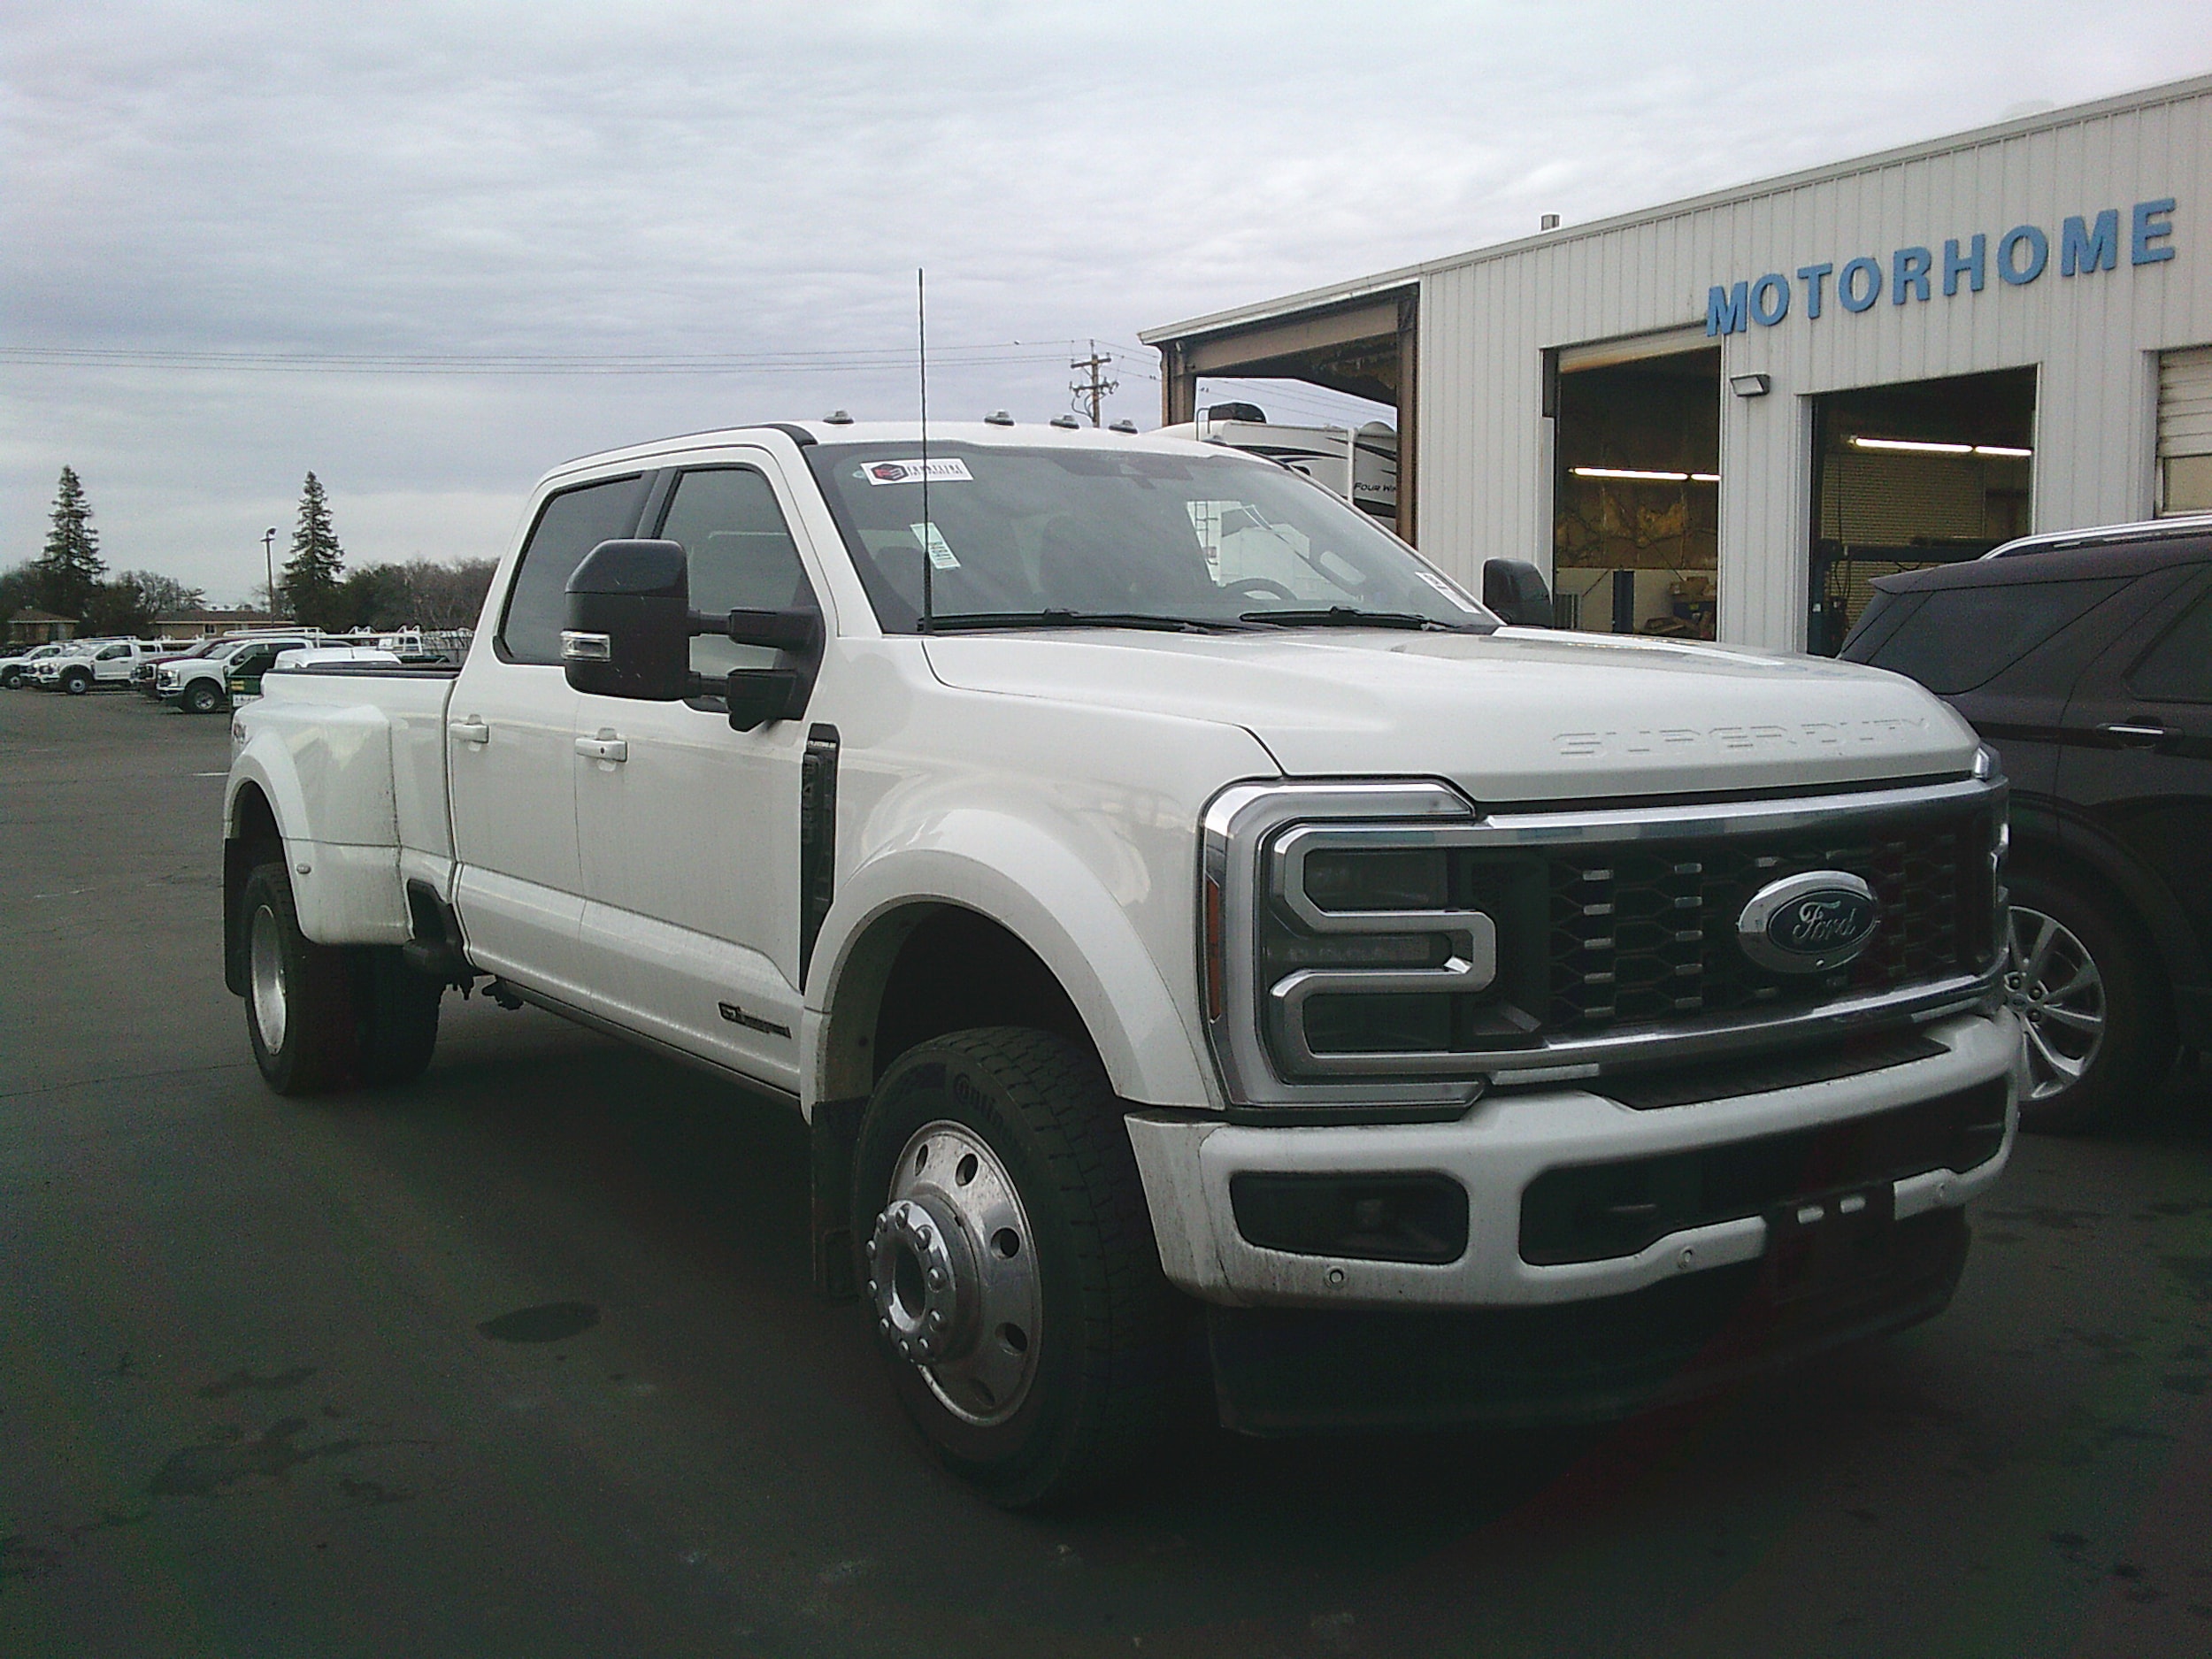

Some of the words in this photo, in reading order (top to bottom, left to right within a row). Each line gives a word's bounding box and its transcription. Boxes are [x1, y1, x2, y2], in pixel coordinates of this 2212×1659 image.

[1706, 197, 2177, 336] MOTORHOME
[1553, 725, 1797, 758] SUPER
[1800, 718, 1930, 749] DUTY
[1793, 901, 1856, 940] Ford
